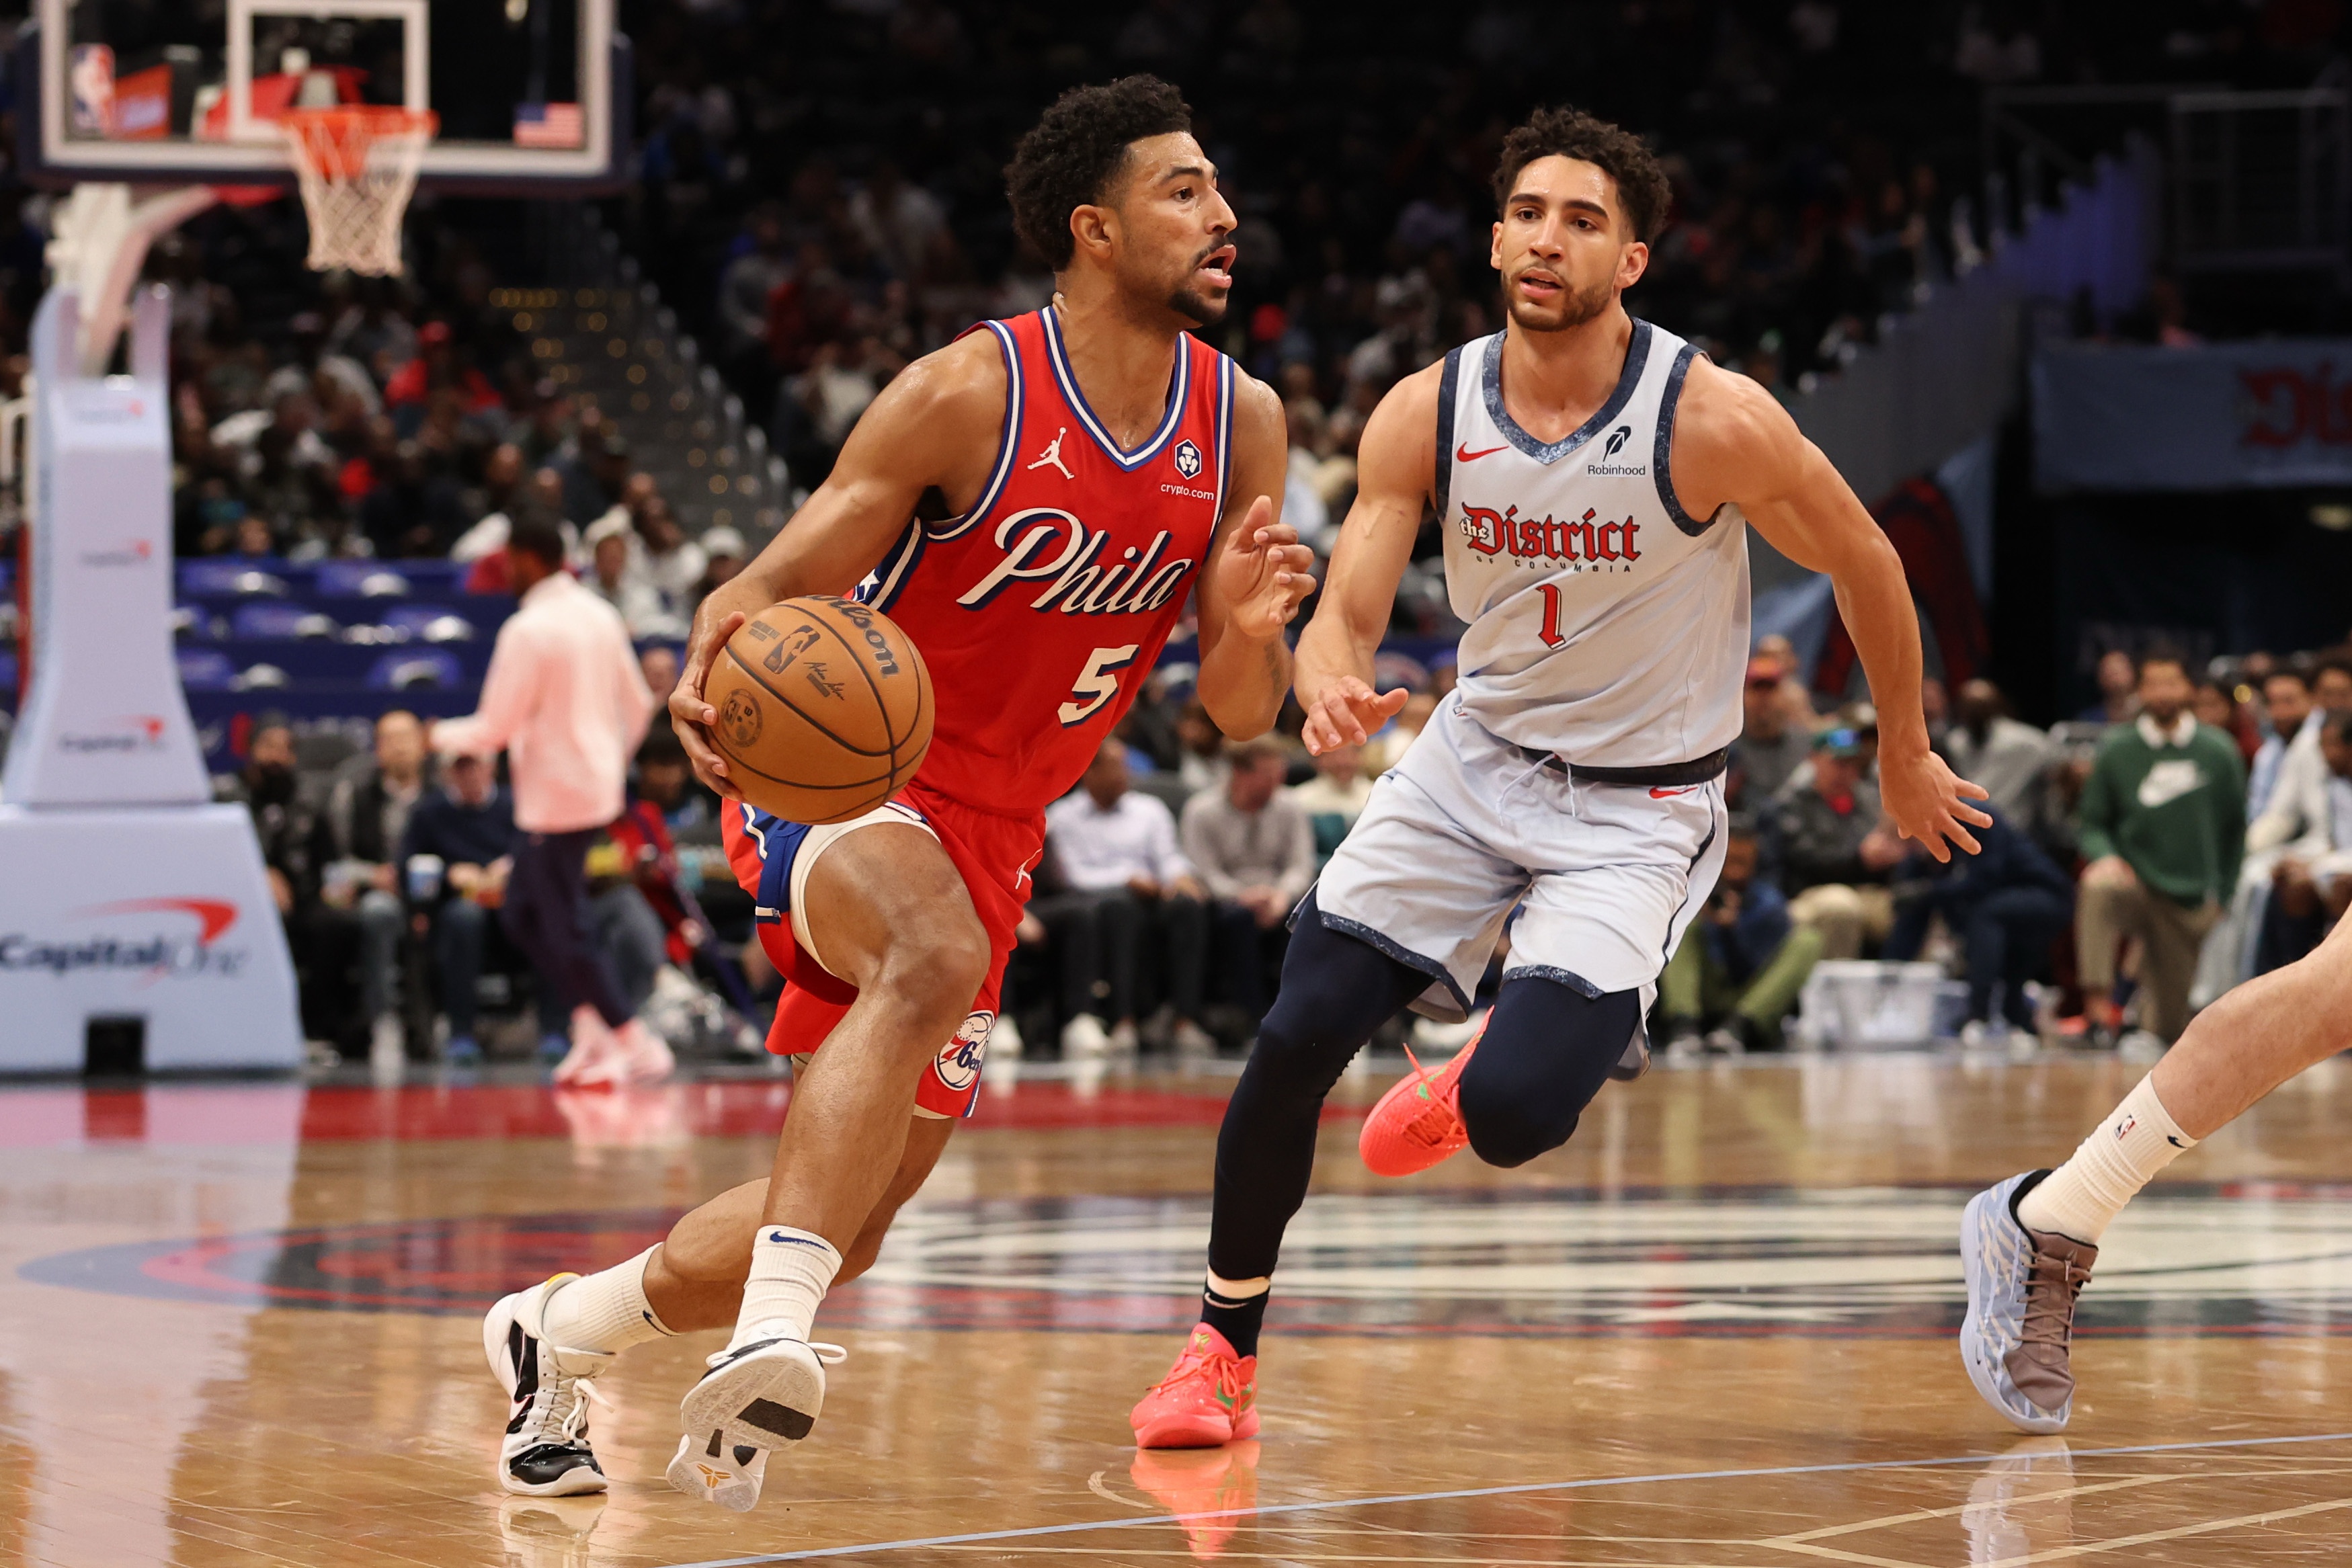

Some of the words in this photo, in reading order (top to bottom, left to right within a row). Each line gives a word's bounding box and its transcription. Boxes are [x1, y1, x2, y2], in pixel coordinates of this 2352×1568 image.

[1588, 464, 1646, 475] Robinhood
[1160, 483, 1215, 501] crypto.com
[1459, 517, 1489, 539] the
[1461, 501, 1641, 562] District
[955, 507, 1196, 616] Phila
[1514, 560, 1631, 573] COLUMBIA
[1535, 583, 1566, 650] 1
[1057, 644, 1141, 729] 5
